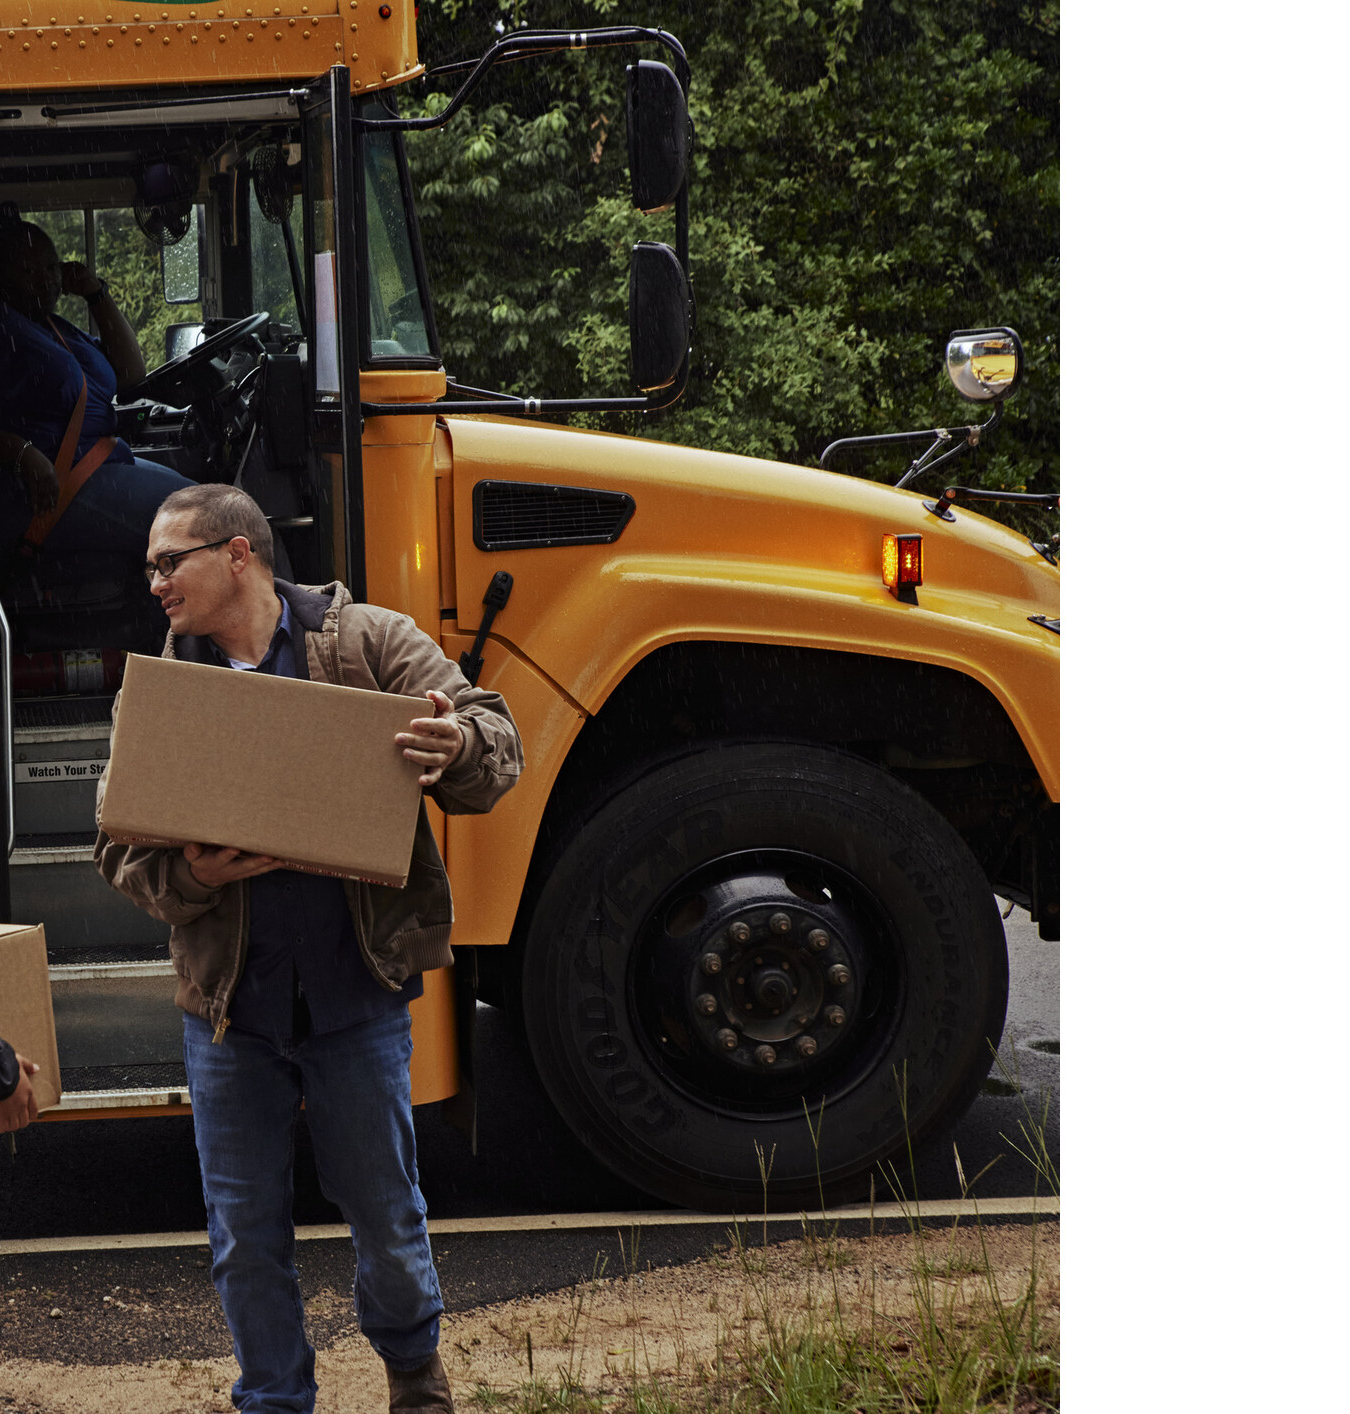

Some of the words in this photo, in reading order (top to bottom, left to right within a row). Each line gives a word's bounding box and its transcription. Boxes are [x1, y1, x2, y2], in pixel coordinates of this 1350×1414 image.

[28, 766, 61, 778] Watch
[63, 764, 87, 776] Your
[90, 763, 106, 775] Ste
